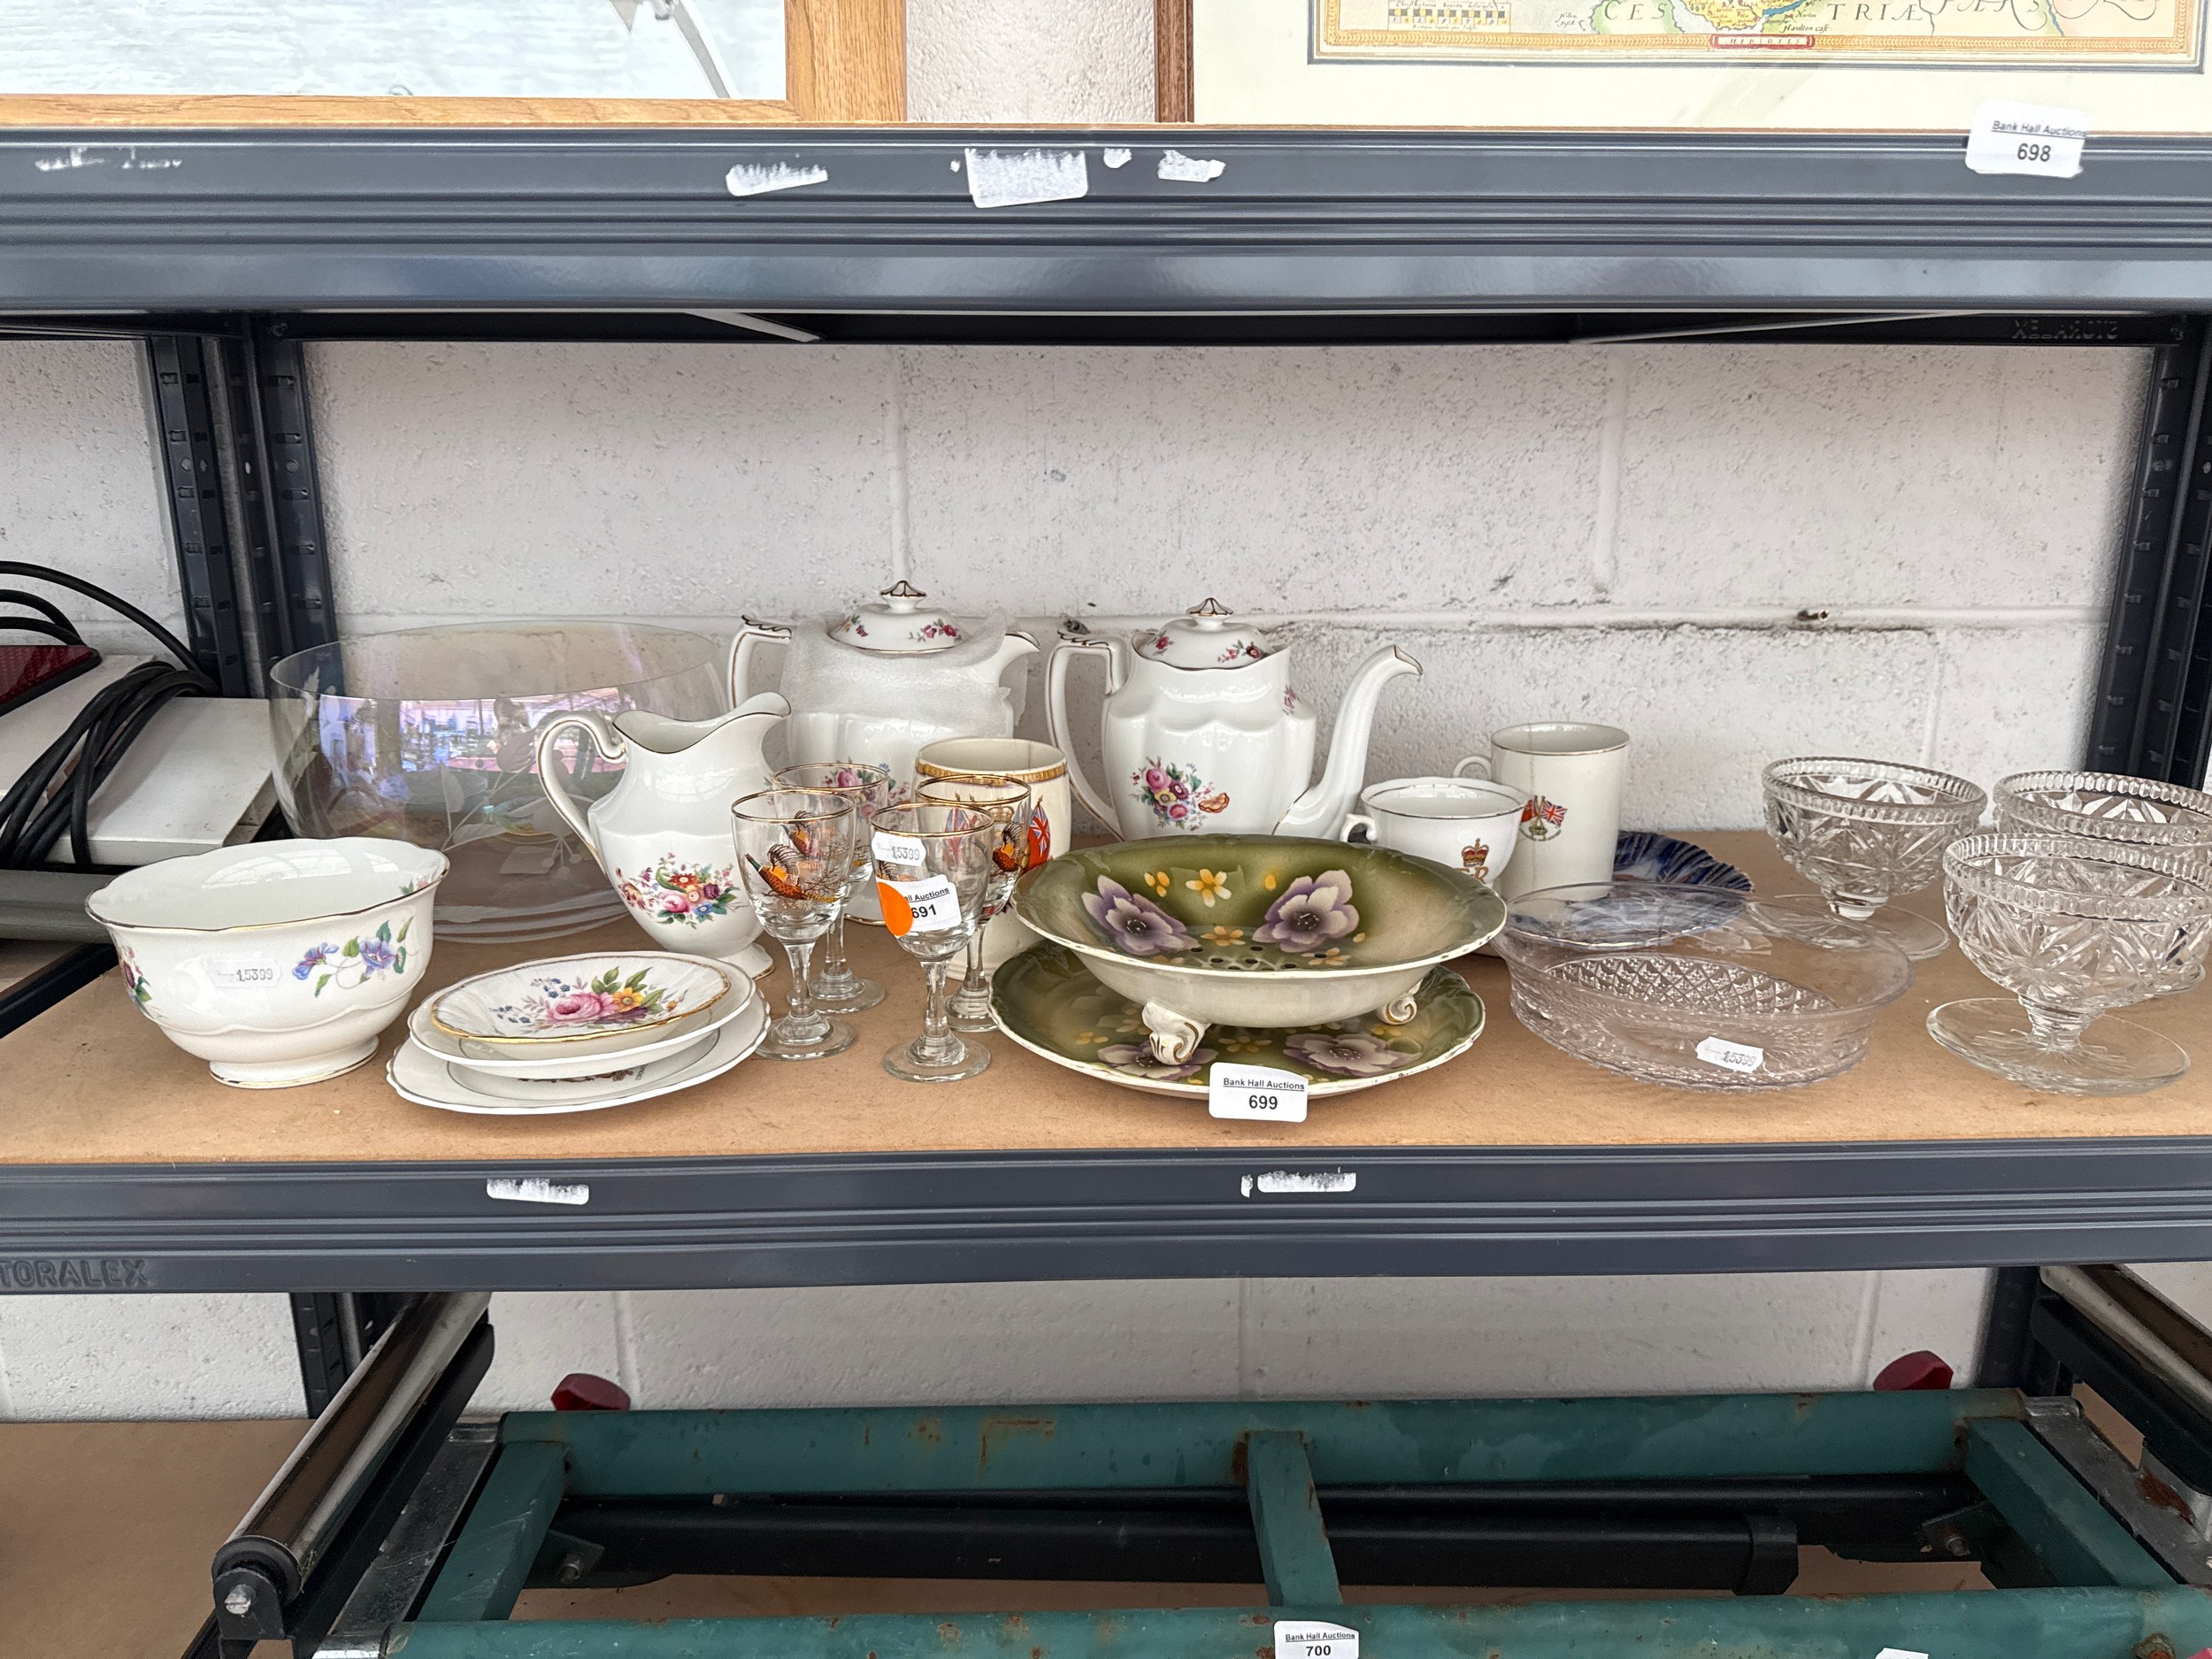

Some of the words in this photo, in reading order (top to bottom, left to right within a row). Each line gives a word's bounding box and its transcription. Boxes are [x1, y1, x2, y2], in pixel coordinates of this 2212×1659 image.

[1992, 120, 2018, 132] Bank
[2021, 122, 2041, 133] Hall
[2043, 125, 2087, 137] Auctions
[2016, 142, 2051, 162] 698
[891, 846, 920, 861] 15399
[915, 887, 950, 901] Auctions
[911, 903, 937, 918] 691
[236, 968, 273, 982] 15399
[1223, 1078, 1246, 1087] Bank
[1248, 1079, 1264, 1087] Hall
[1266, 1080, 1305, 1090] Auctions
[1248, 1094, 1278, 1110] 699
[1305, 1645, 1332, 1657] 700
